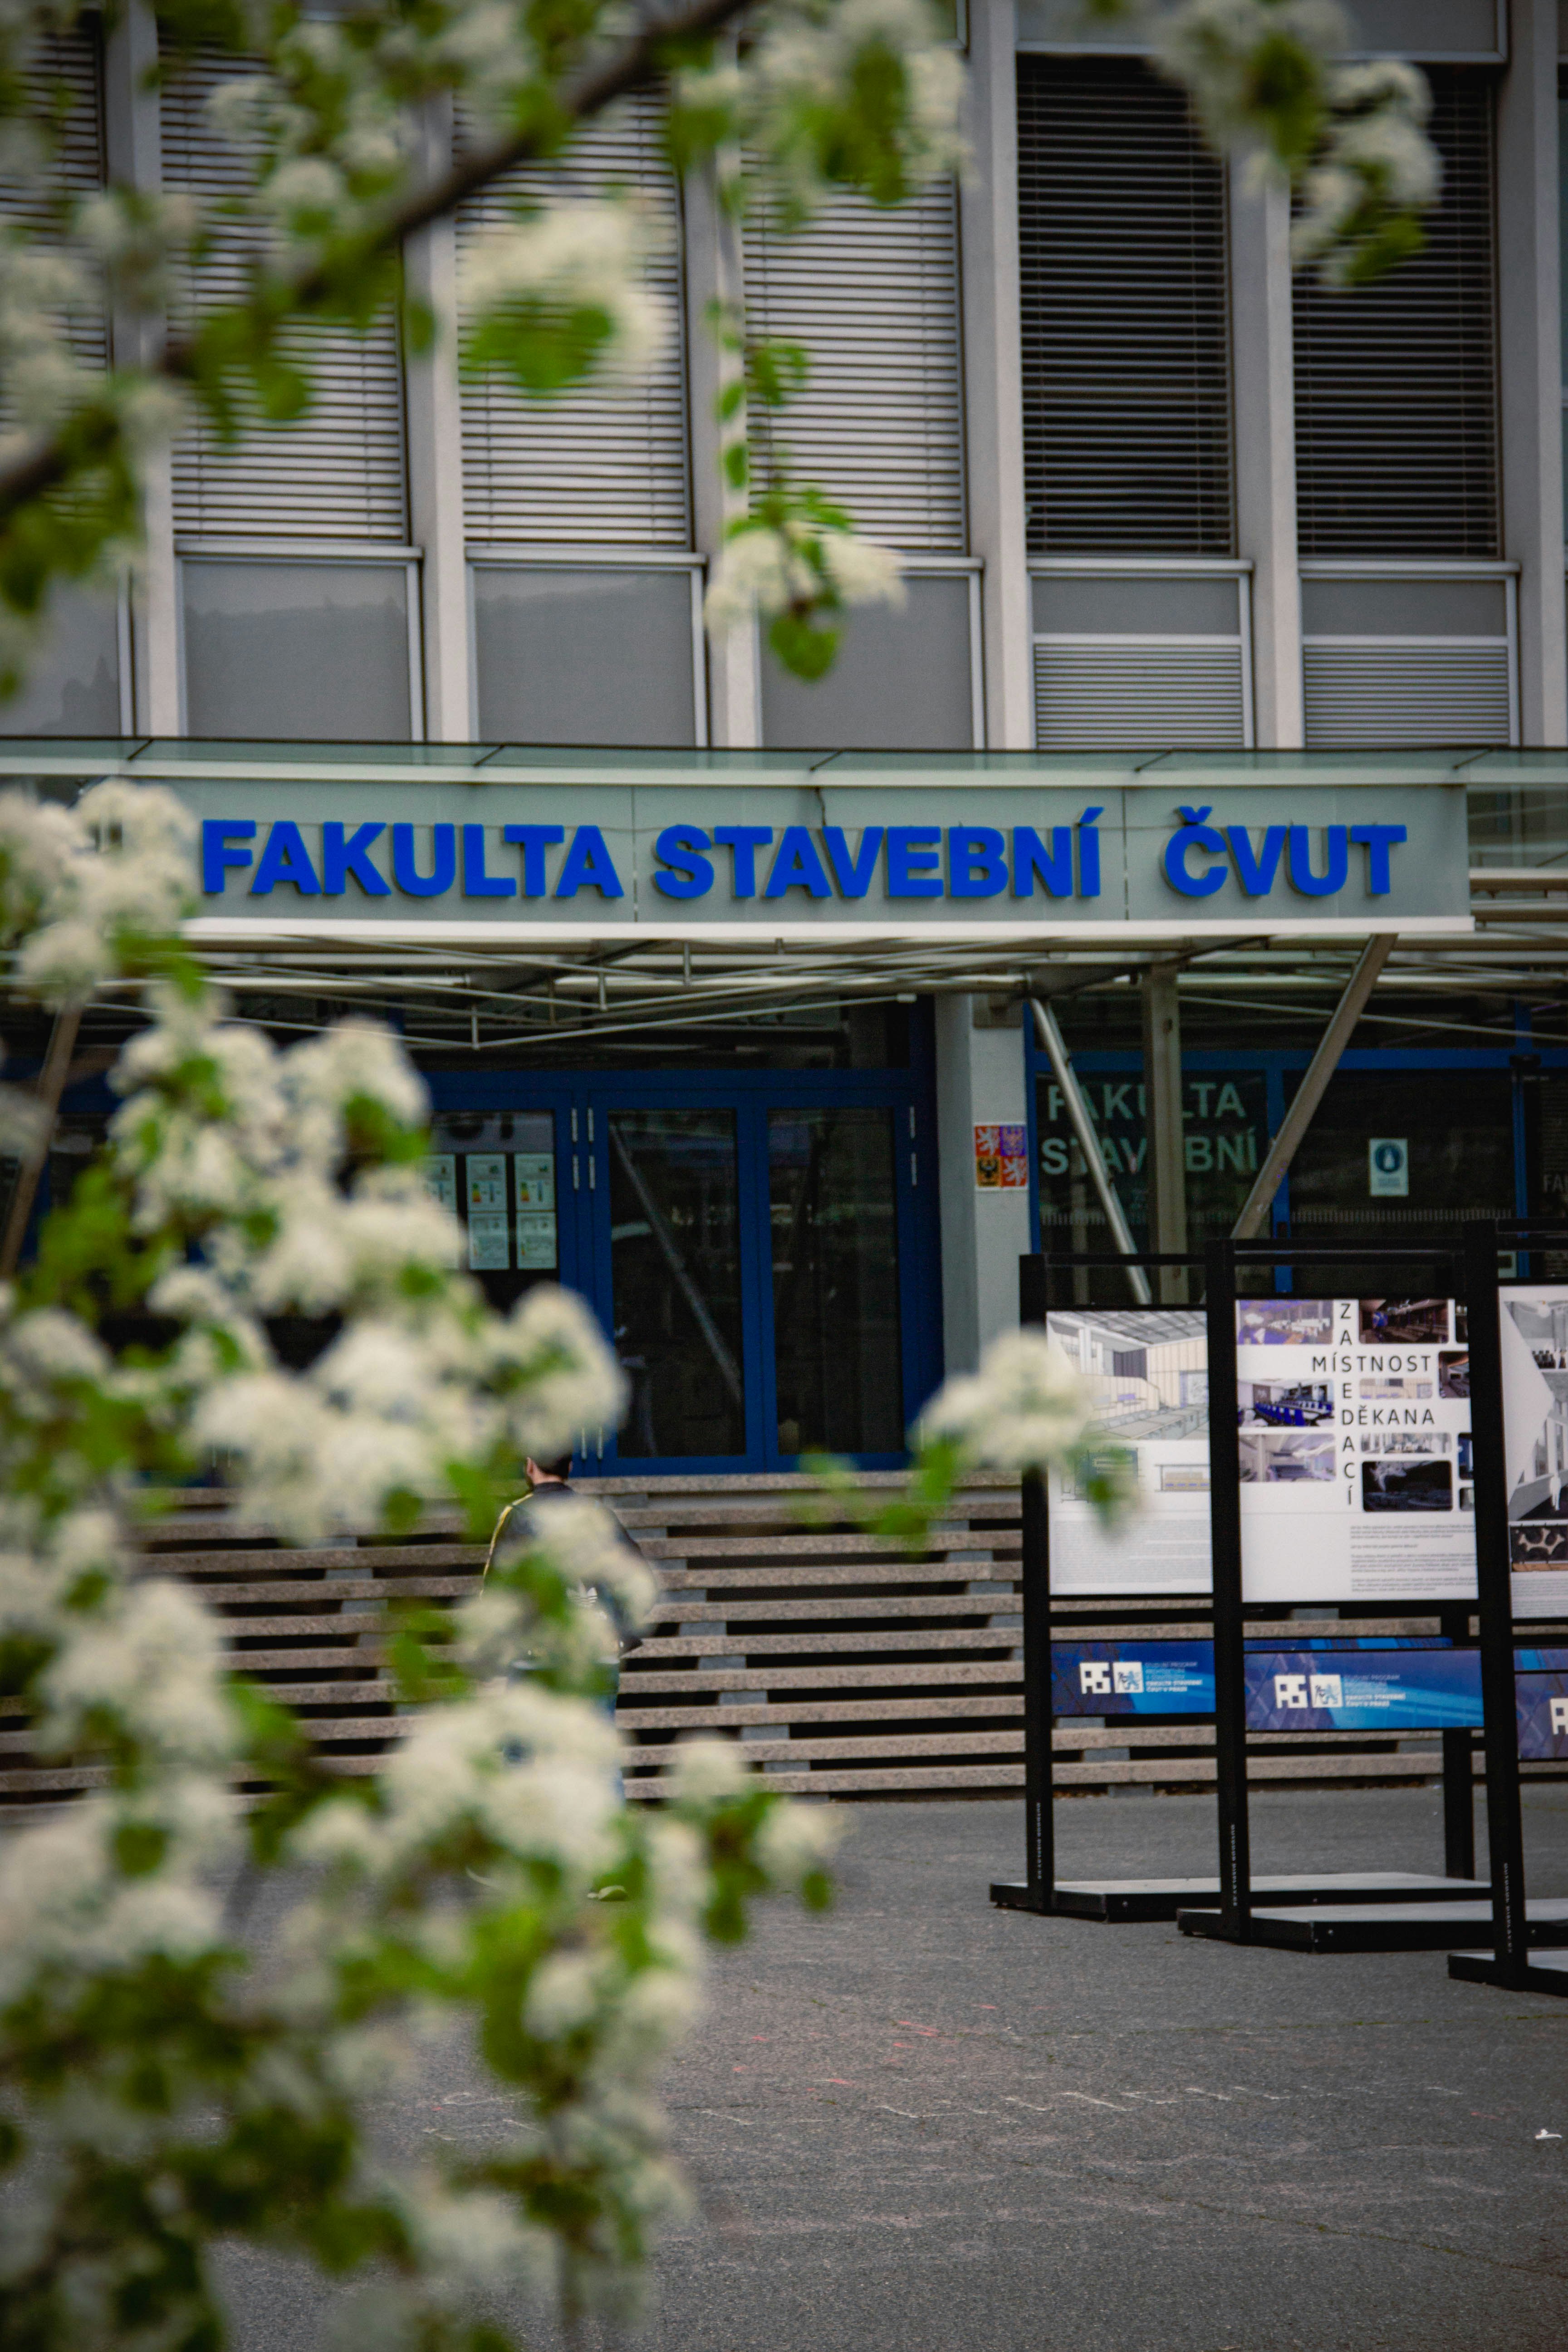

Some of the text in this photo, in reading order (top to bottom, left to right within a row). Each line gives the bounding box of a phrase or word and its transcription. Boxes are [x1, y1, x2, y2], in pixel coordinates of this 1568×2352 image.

[202, 805, 1407, 899] FAKULTA STAVEBNÍ ČVUT
[1041, 1125, 1258, 1176] SAVBNÍ
[1312, 1352, 1431, 1372] MÍSTNOST
[1342, 1405, 1436, 1426] DĚKANA
